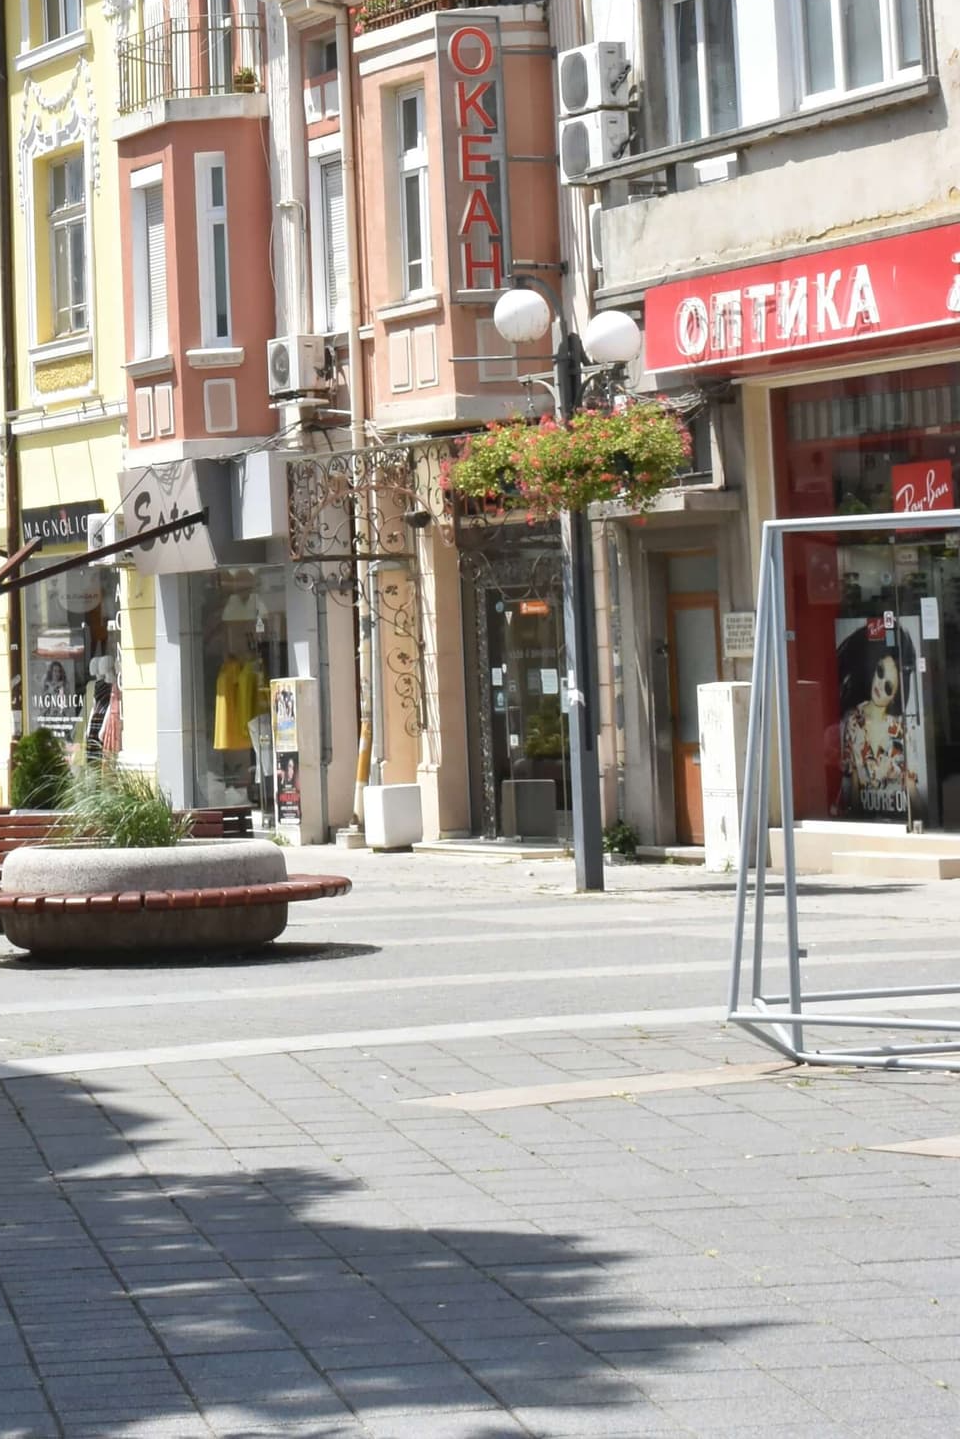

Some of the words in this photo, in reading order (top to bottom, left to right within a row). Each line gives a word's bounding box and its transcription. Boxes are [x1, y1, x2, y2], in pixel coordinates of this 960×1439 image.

[676, 264, 880, 357] ОПТИКА
[23, 514, 88, 539] MAGNOLIC
[32, 694, 84, 709] MAGNOLICA
